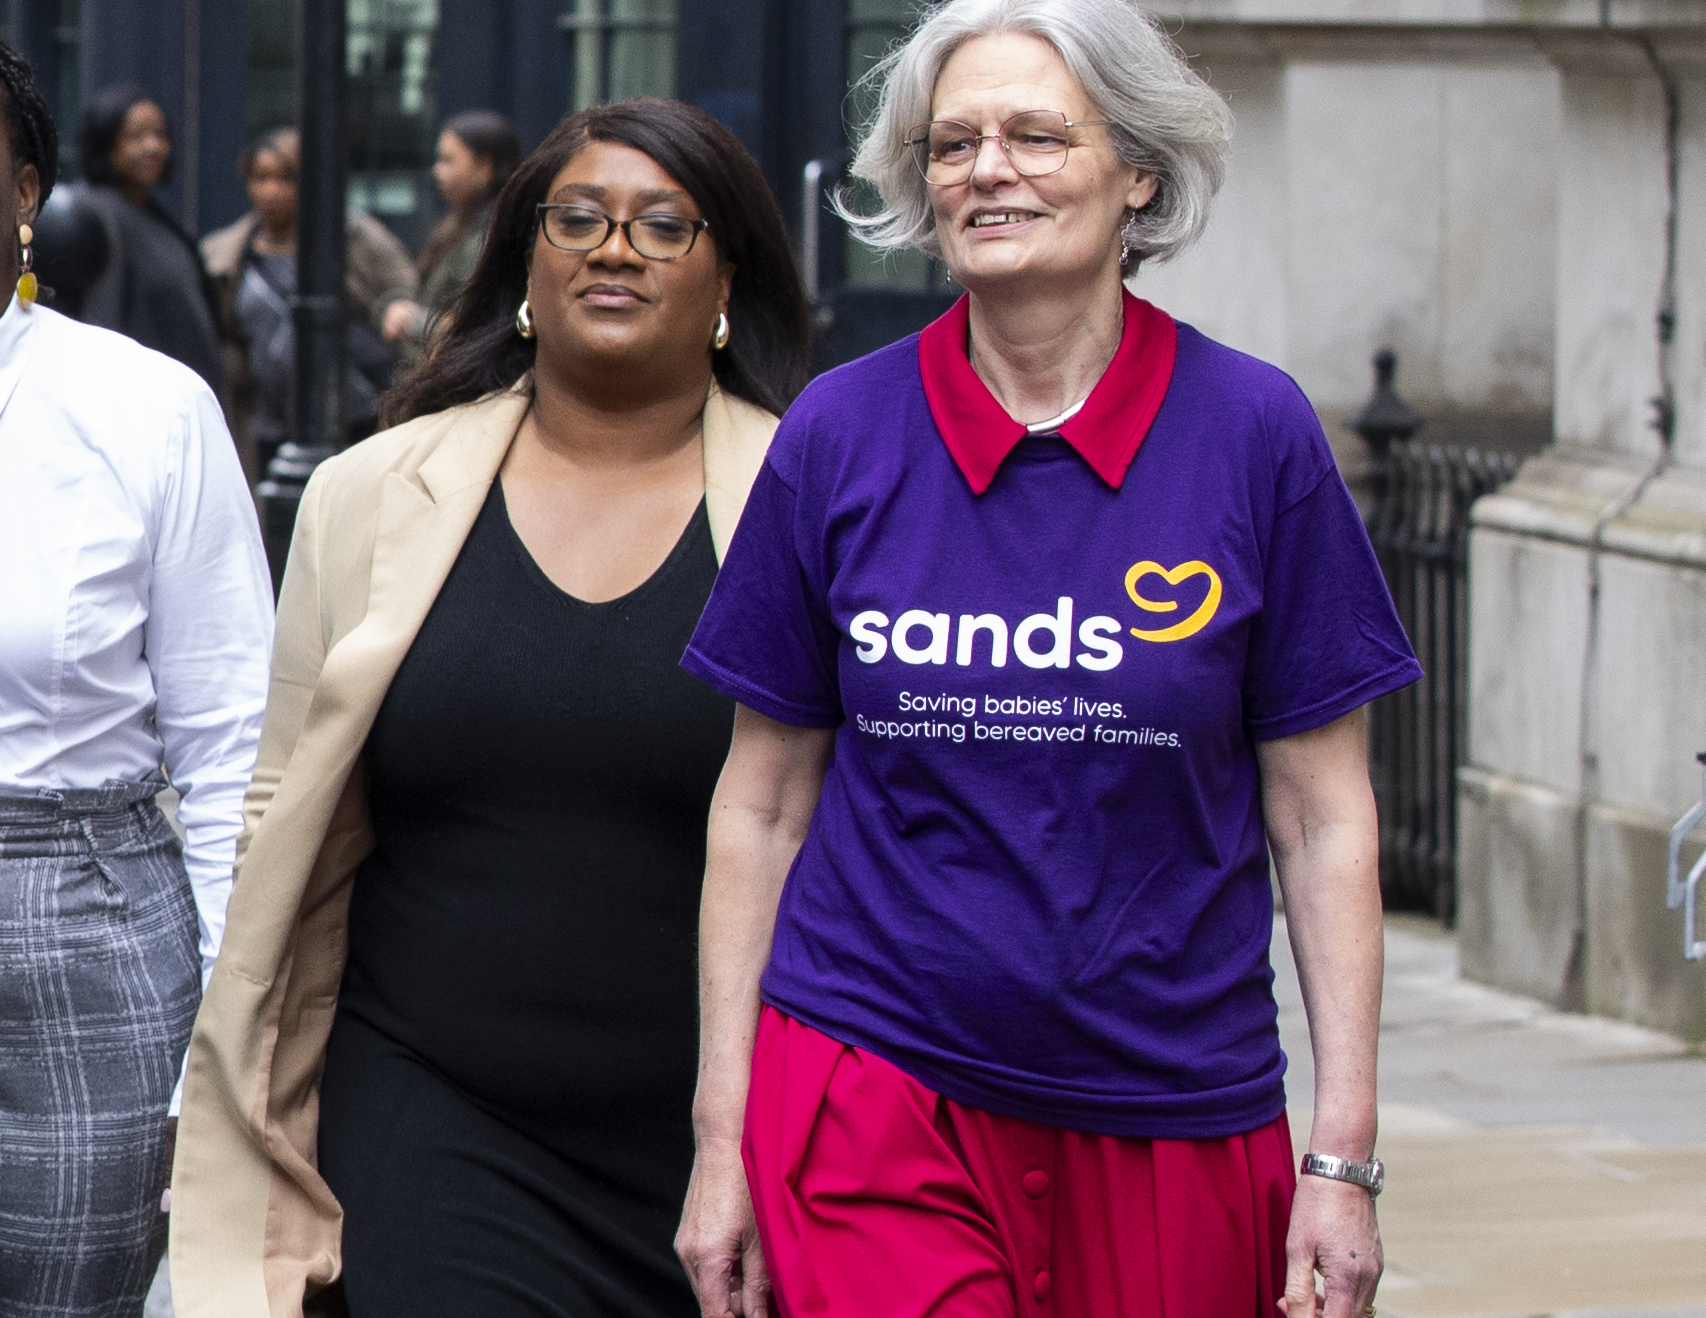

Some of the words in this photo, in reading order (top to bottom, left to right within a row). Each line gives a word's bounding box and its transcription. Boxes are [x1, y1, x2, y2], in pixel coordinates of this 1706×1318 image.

[848, 595, 1124, 672] sands
[898, 691, 976, 717] Saving
[1073, 695, 1128, 719] lives.
[855, 713, 966, 742] Supporting
[973, 721, 1086, 743] bereaved
[1092, 724, 1183, 748] families.
